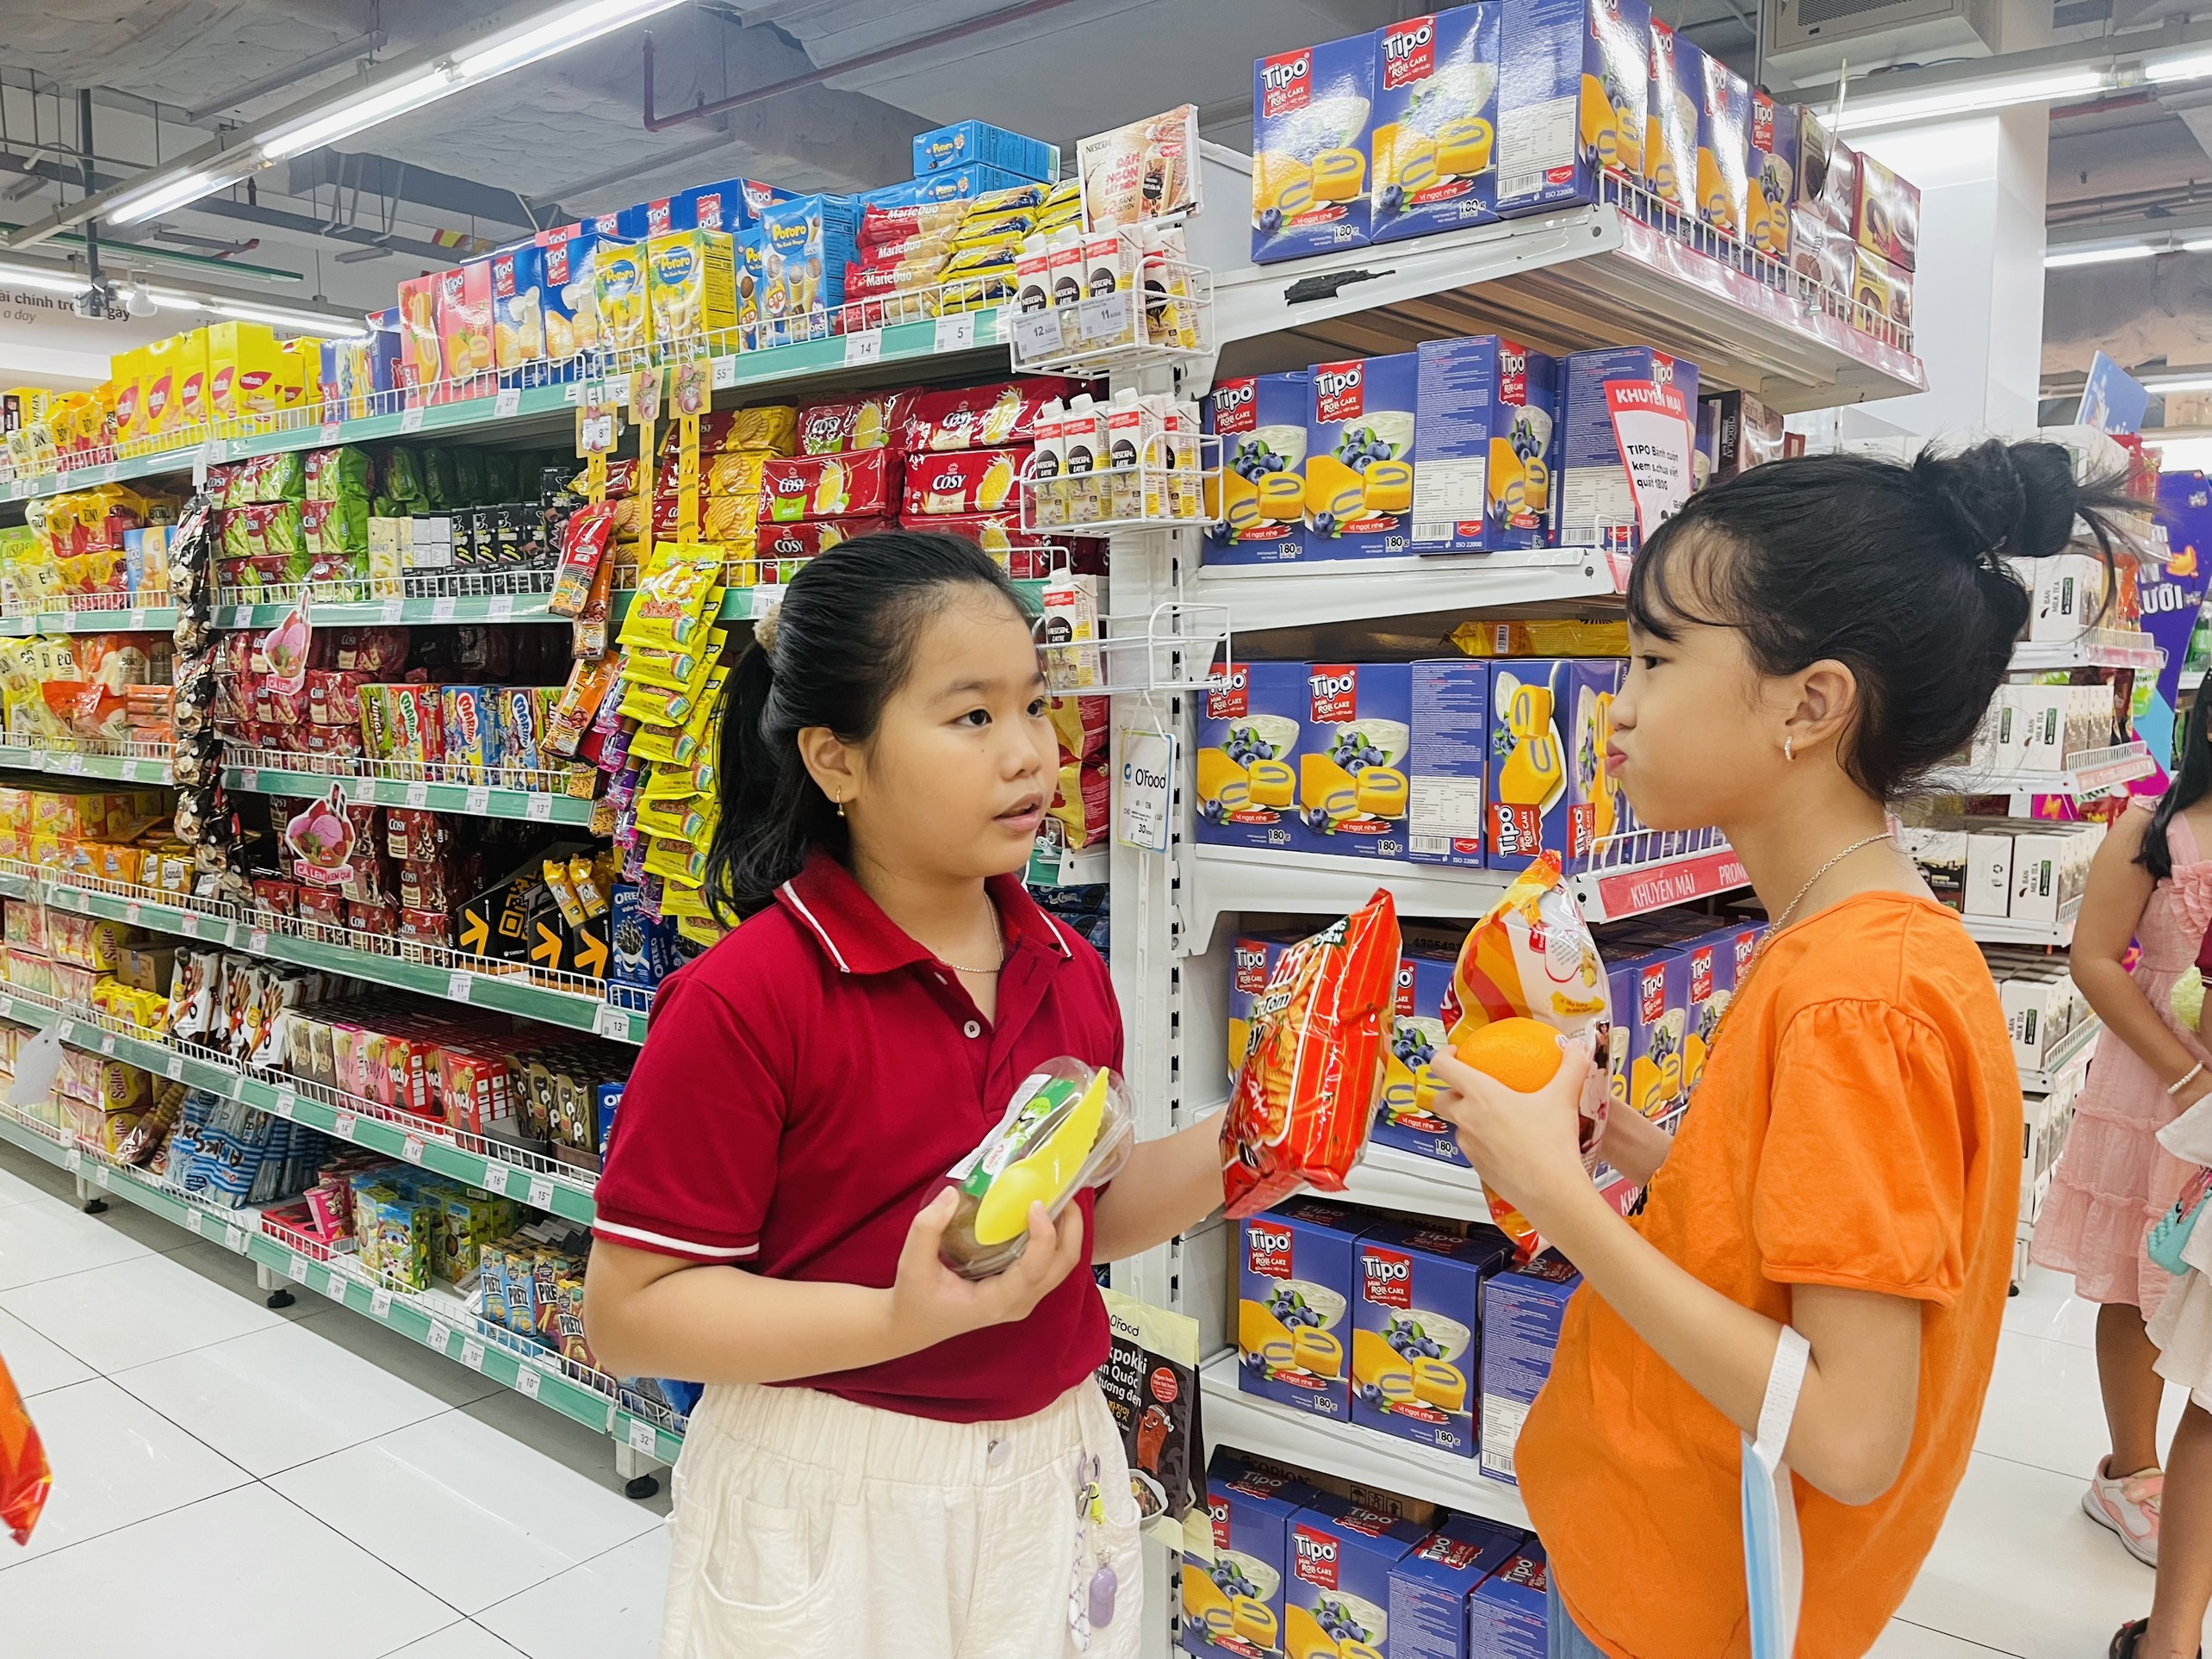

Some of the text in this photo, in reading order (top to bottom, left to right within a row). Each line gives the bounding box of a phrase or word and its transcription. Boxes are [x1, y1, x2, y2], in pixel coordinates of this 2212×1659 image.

[1382, 25, 1432, 62] Tipo
[1260, 57, 1309, 92] Tipo
[1753, 98, 1773, 126] Tipo
[647, 203, 669, 226] Tipo
[888, 206, 939, 220] MarieDuo
[1459, 199, 1477, 214] 180
[772, 224, 806, 241] Pororo
[1334, 226, 1351, 238] 180
[878, 241, 921, 258] MarieDuo
[494, 261, 513, 280] Tipo
[661, 256, 690, 271] Pororo
[606, 269, 634, 283] Pororo
[866, 270, 911, 287] MarieDuo
[15, 291, 53, 308] chính
[18, 311, 37, 325] day
[957, 326, 963, 338] 5
[861, 344, 871, 354] 14
[1499, 350, 1525, 381] Tipo
[717, 370, 726, 379] 55
[1314, 365, 1362, 399] Tipo
[1211, 382, 1255, 414] Tipo
[1324, 395, 1357, 413] ROLL CAKE
[1220, 413, 1234, 426] ROLL
[1235, 410, 1251, 420] CAKE
[1627, 444, 1650, 456] TIPO
[1652, 445, 1666, 461] Bánh
[1633, 460, 1651, 472] kem
[779, 478, 806, 494] COSY
[932, 475, 966, 490] COSY
[1637, 475, 1668, 491] quất 180G
[1245, 527, 1278, 541] vị ngọt nhẹ
[1349, 520, 1385, 533] vị ngọt nhẹ
[774, 539, 804, 553] COSY
[1278, 543, 1296, 556] 180
[1384, 536, 1403, 549] 180
[1308, 674, 1354, 700] Tipo
[1318, 700, 1350, 713] ROLL CAKE
[370, 696, 383, 743] JUNGLE
[1135, 768, 1166, 789] O'Food
[389, 818, 406, 831] COSY
[1349, 823, 1363, 832] ngọt
[1497, 805, 1521, 858] Tipo
[1268, 829, 1284, 840] 180
[1378, 840, 1395, 851] 180
[311, 869, 326, 882] LEM
[351, 916, 366, 929] COSY
[651, 937, 664, 979] OREO
[1235, 949, 1265, 972] Tipo
[1735, 941, 1753, 964] Tipo
[1691, 954, 1711, 980] Tipo
[1641, 972, 1664, 1000] Tipo
[613, 1022, 622, 1032] 13
[1435, 1139, 1451, 1153] 180
[537, 1190, 545, 1200] 15
[1246, 1228, 1290, 1254] Tipo
[1256, 1256, 1286, 1266] ROLL CAKE
[1362, 1255, 1409, 1283] Tipo
[483, 1275, 502, 1296] PRETZ
[1371, 1285, 1404, 1296] ROLL CAKE
[508, 1288, 529, 1306] PRETZ
[561, 1314, 583, 1336] PRETZ
[526, 1377, 533, 1388] 10
[1112, 1365, 1139, 1389] Quốc
[1286, 1373, 1300, 1385] ngọt
[1300, 1377, 1313, 1387] nhẹ
[1127, 1390, 1142, 1407] đen
[1314, 1395, 1331, 1409] 180
[1398, 1405, 1433, 1420] vị ngọt nhẹ
[640, 1434, 649, 1445] 32
[1435, 1429, 1453, 1443] 180
[1243, 1470, 1283, 1487] Tipo
[1349, 1507, 1393, 1524] Tipo
[1293, 1533, 1336, 1562] Tipo
[1418, 1538, 1452, 1562] Tipo
[1302, 1563, 1332, 1576] ROLL CAKE
[1501, 1559, 1534, 1583] Tipo
